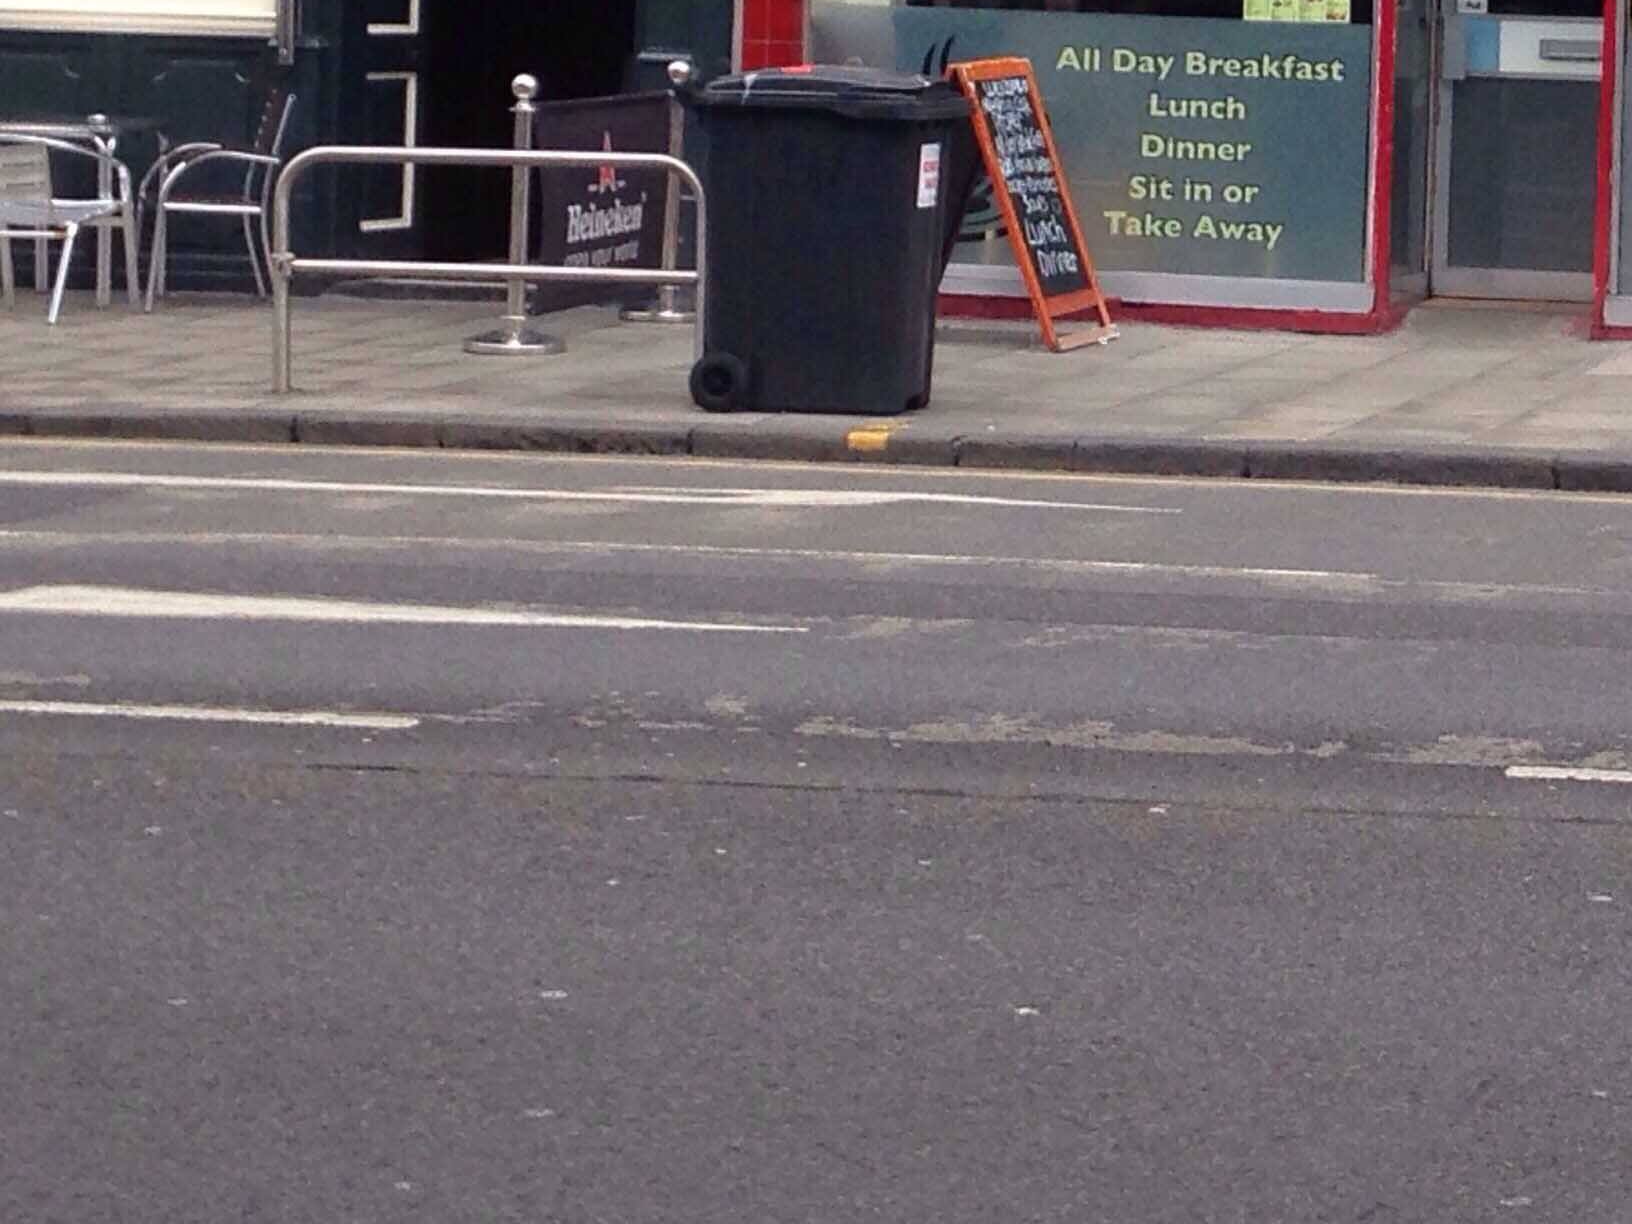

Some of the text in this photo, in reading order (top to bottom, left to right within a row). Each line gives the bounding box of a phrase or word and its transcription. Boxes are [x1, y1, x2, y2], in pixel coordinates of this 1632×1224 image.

[1056, 46, 1346, 82] All Day Breakfast
[1150, 93, 1247, 120] Lunch
[1140, 134, 1252, 162] Dinner
[1128, 175, 1260, 203] Sit in or
[1103, 210, 1283, 251] Take Away
